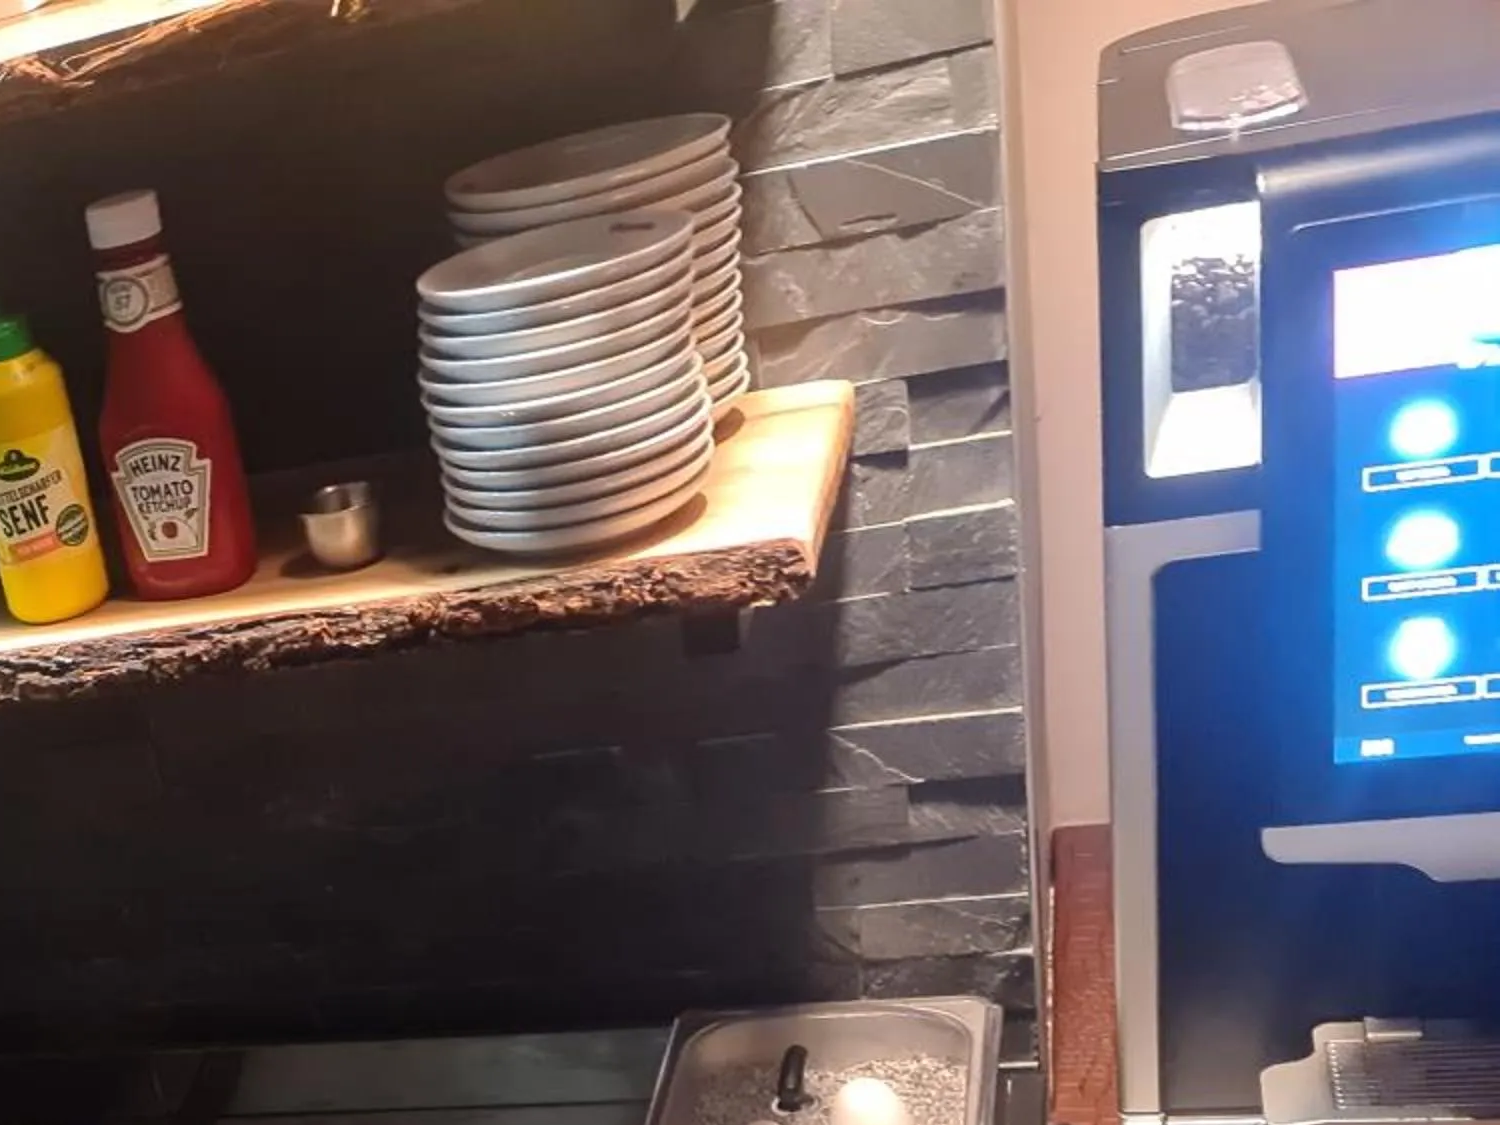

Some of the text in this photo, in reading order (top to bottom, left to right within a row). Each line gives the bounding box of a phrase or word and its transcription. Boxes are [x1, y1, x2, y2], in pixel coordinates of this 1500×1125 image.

[128, 453, 181, 476] HEINZ
[131, 479, 194, 501] TOMATO
[138, 497, 192, 513] KETCHUP
